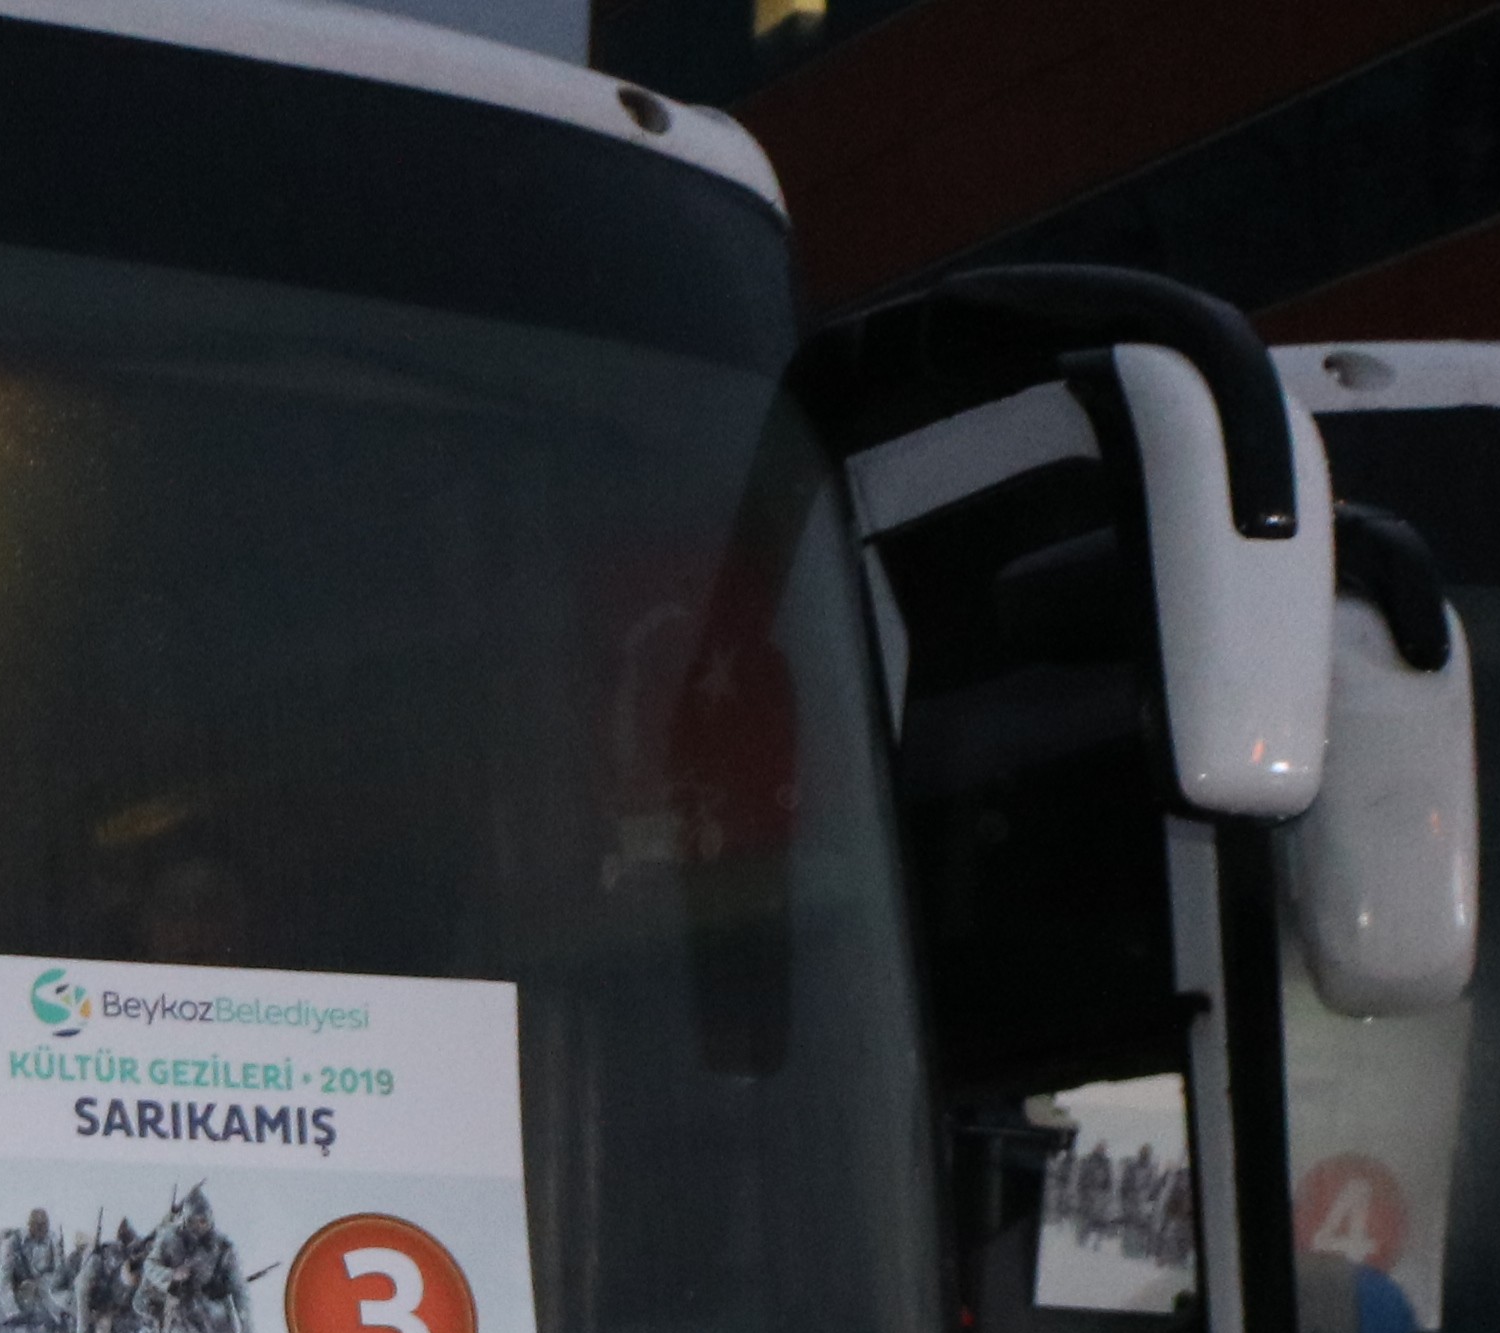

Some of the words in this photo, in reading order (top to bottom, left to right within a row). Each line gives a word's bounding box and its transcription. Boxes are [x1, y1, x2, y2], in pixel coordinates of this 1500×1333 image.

[9, 1045, 141, 1085] KÜLTÜR
[148, 1053, 294, 1091] GEZİLERİ
[320, 1065, 395, 1096] 2019
[74, 1096, 338, 1157] SARIKAMIŞ
[1312, 1178, 1379, 1263] 4
